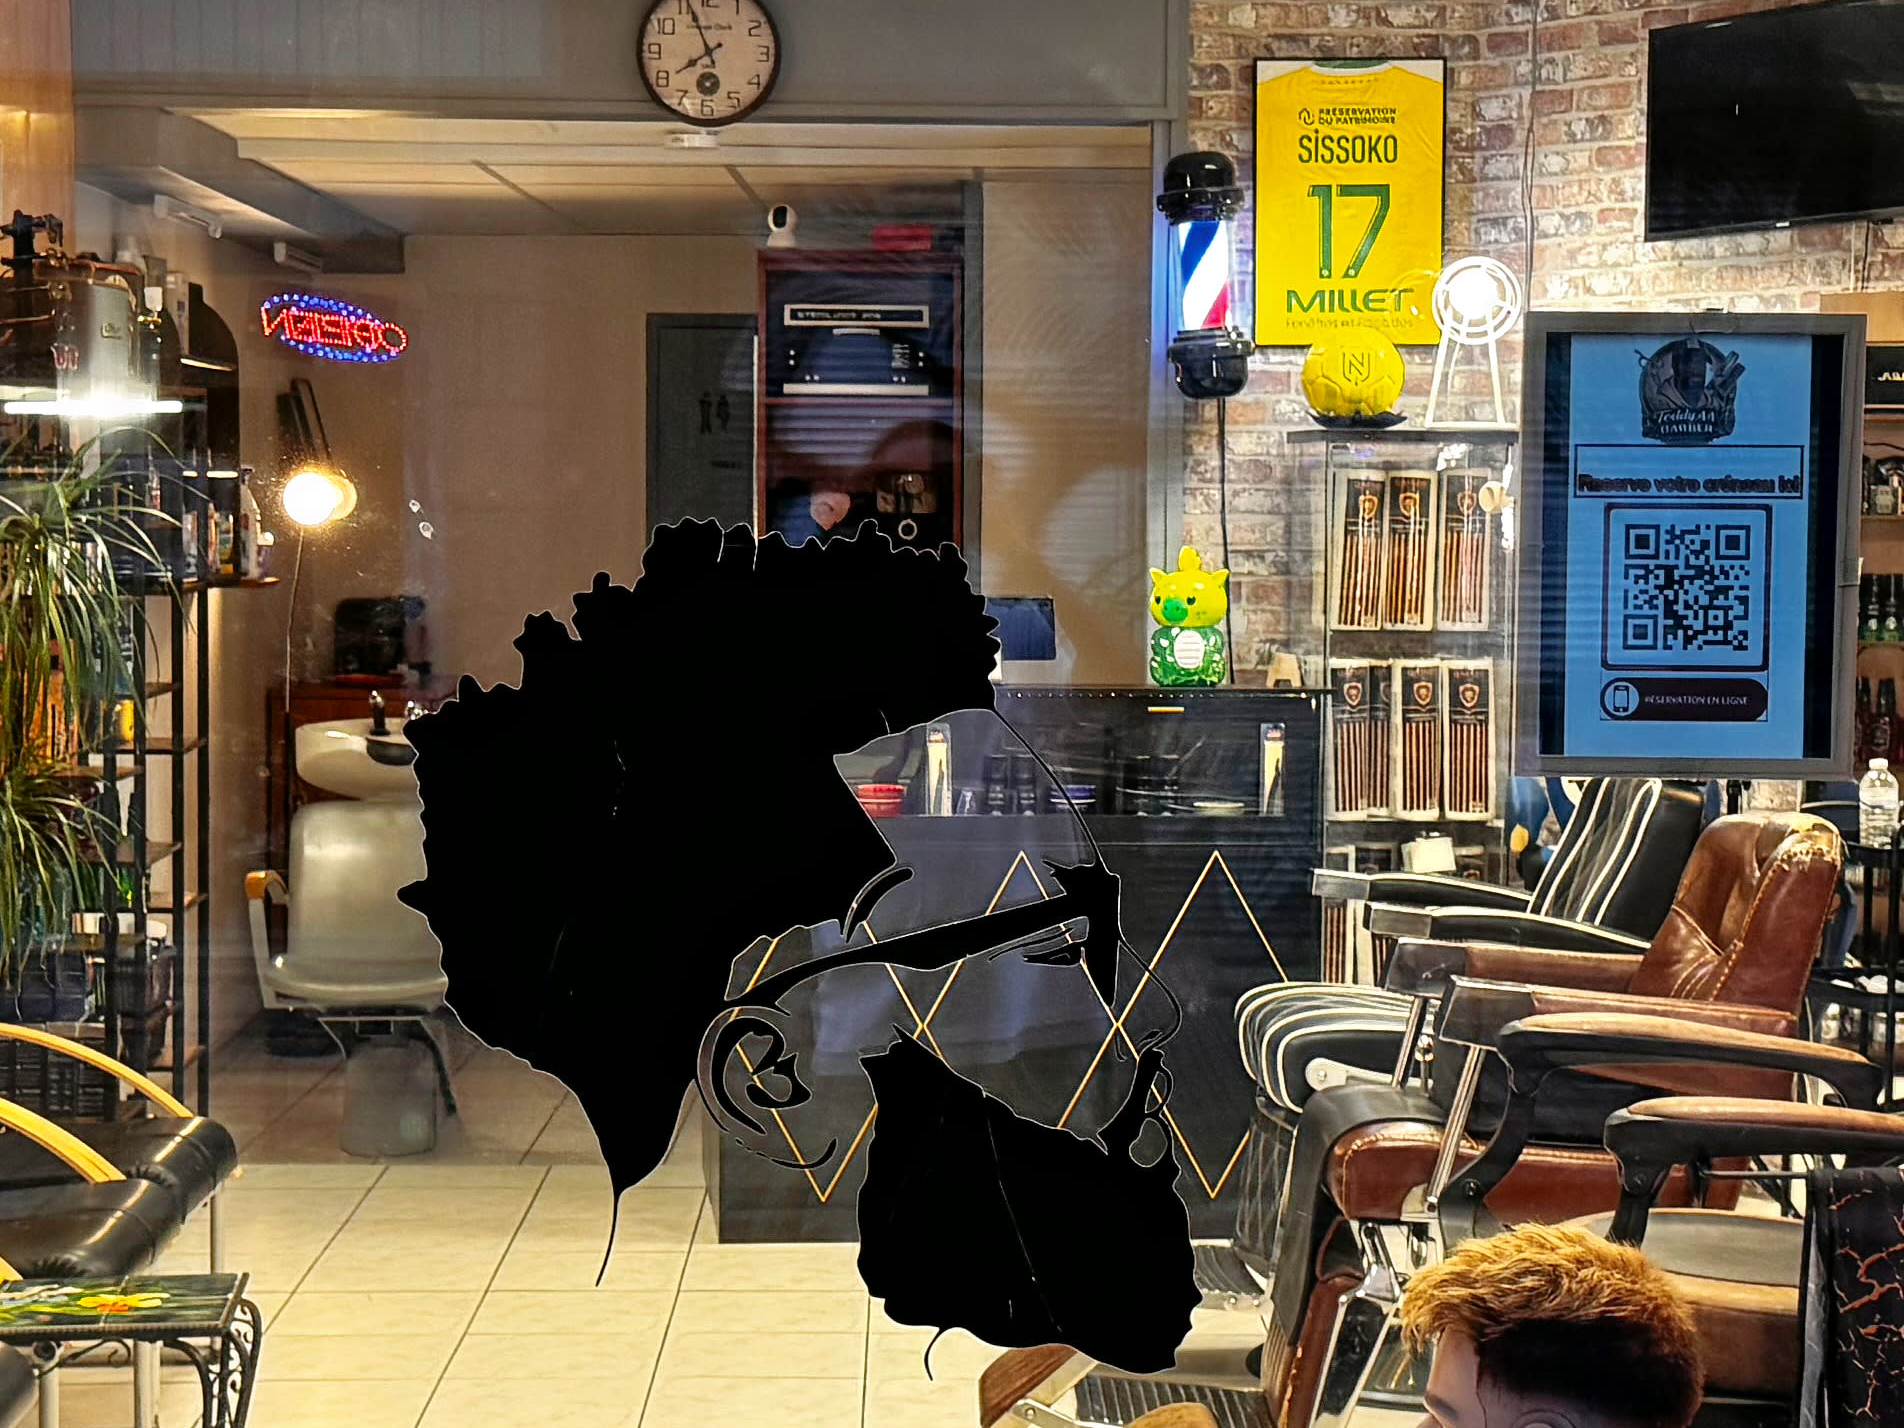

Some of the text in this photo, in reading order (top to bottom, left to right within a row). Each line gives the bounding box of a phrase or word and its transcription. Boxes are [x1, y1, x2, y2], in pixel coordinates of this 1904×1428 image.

[657, 17, 676, 35] 10
[748, 20, 762, 37] 2
[648, 43, 662, 60] 9
[757, 45, 770, 62] 3
[656, 70, 670, 88] 8
[747, 74, 761, 90] 4
[676, 89, 689, 106] 7
[727, 91, 741, 108] 5
[700, 99, 714, 116] 6
[1307, 184, 1390, 278] 17
[1286, 288, 1415, 313] MILLET
